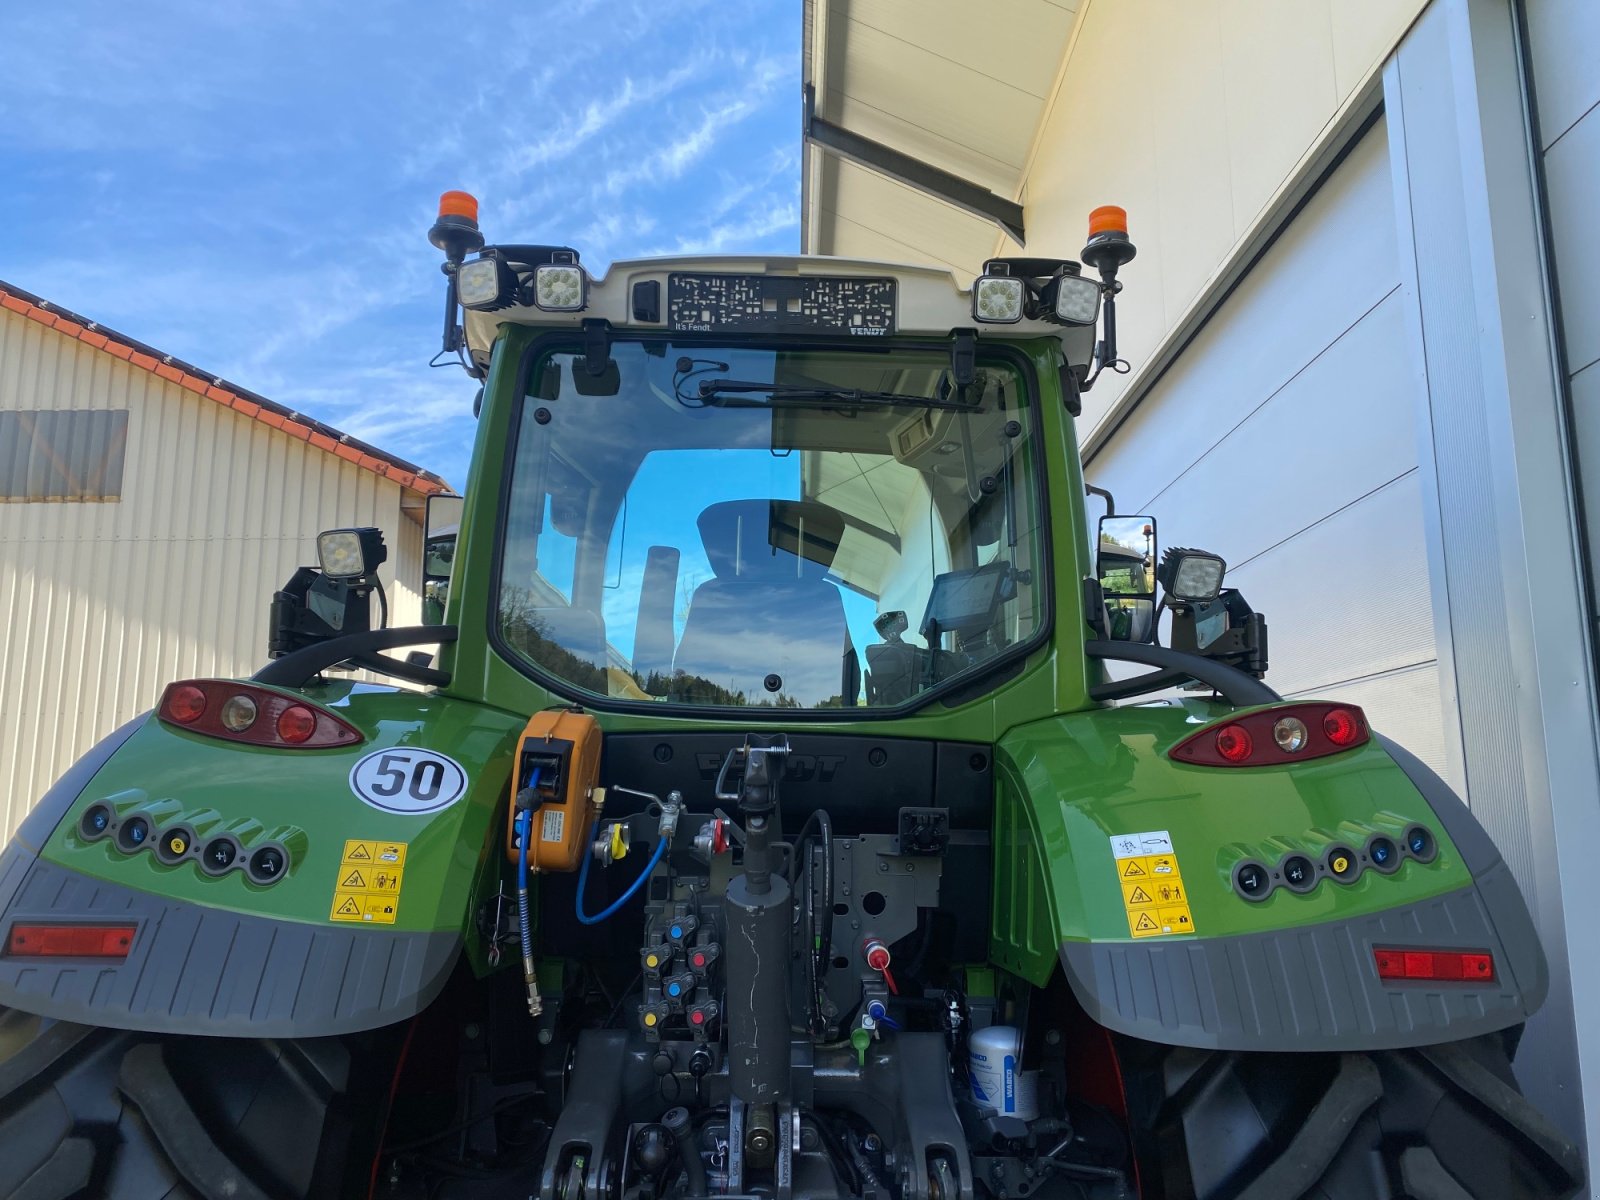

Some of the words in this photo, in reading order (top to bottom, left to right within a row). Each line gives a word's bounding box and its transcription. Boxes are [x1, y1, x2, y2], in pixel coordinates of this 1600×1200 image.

[850, 328, 887, 336] FENDT
[371, 755, 445, 801] 50
[696, 753, 847, 782] FEDT
